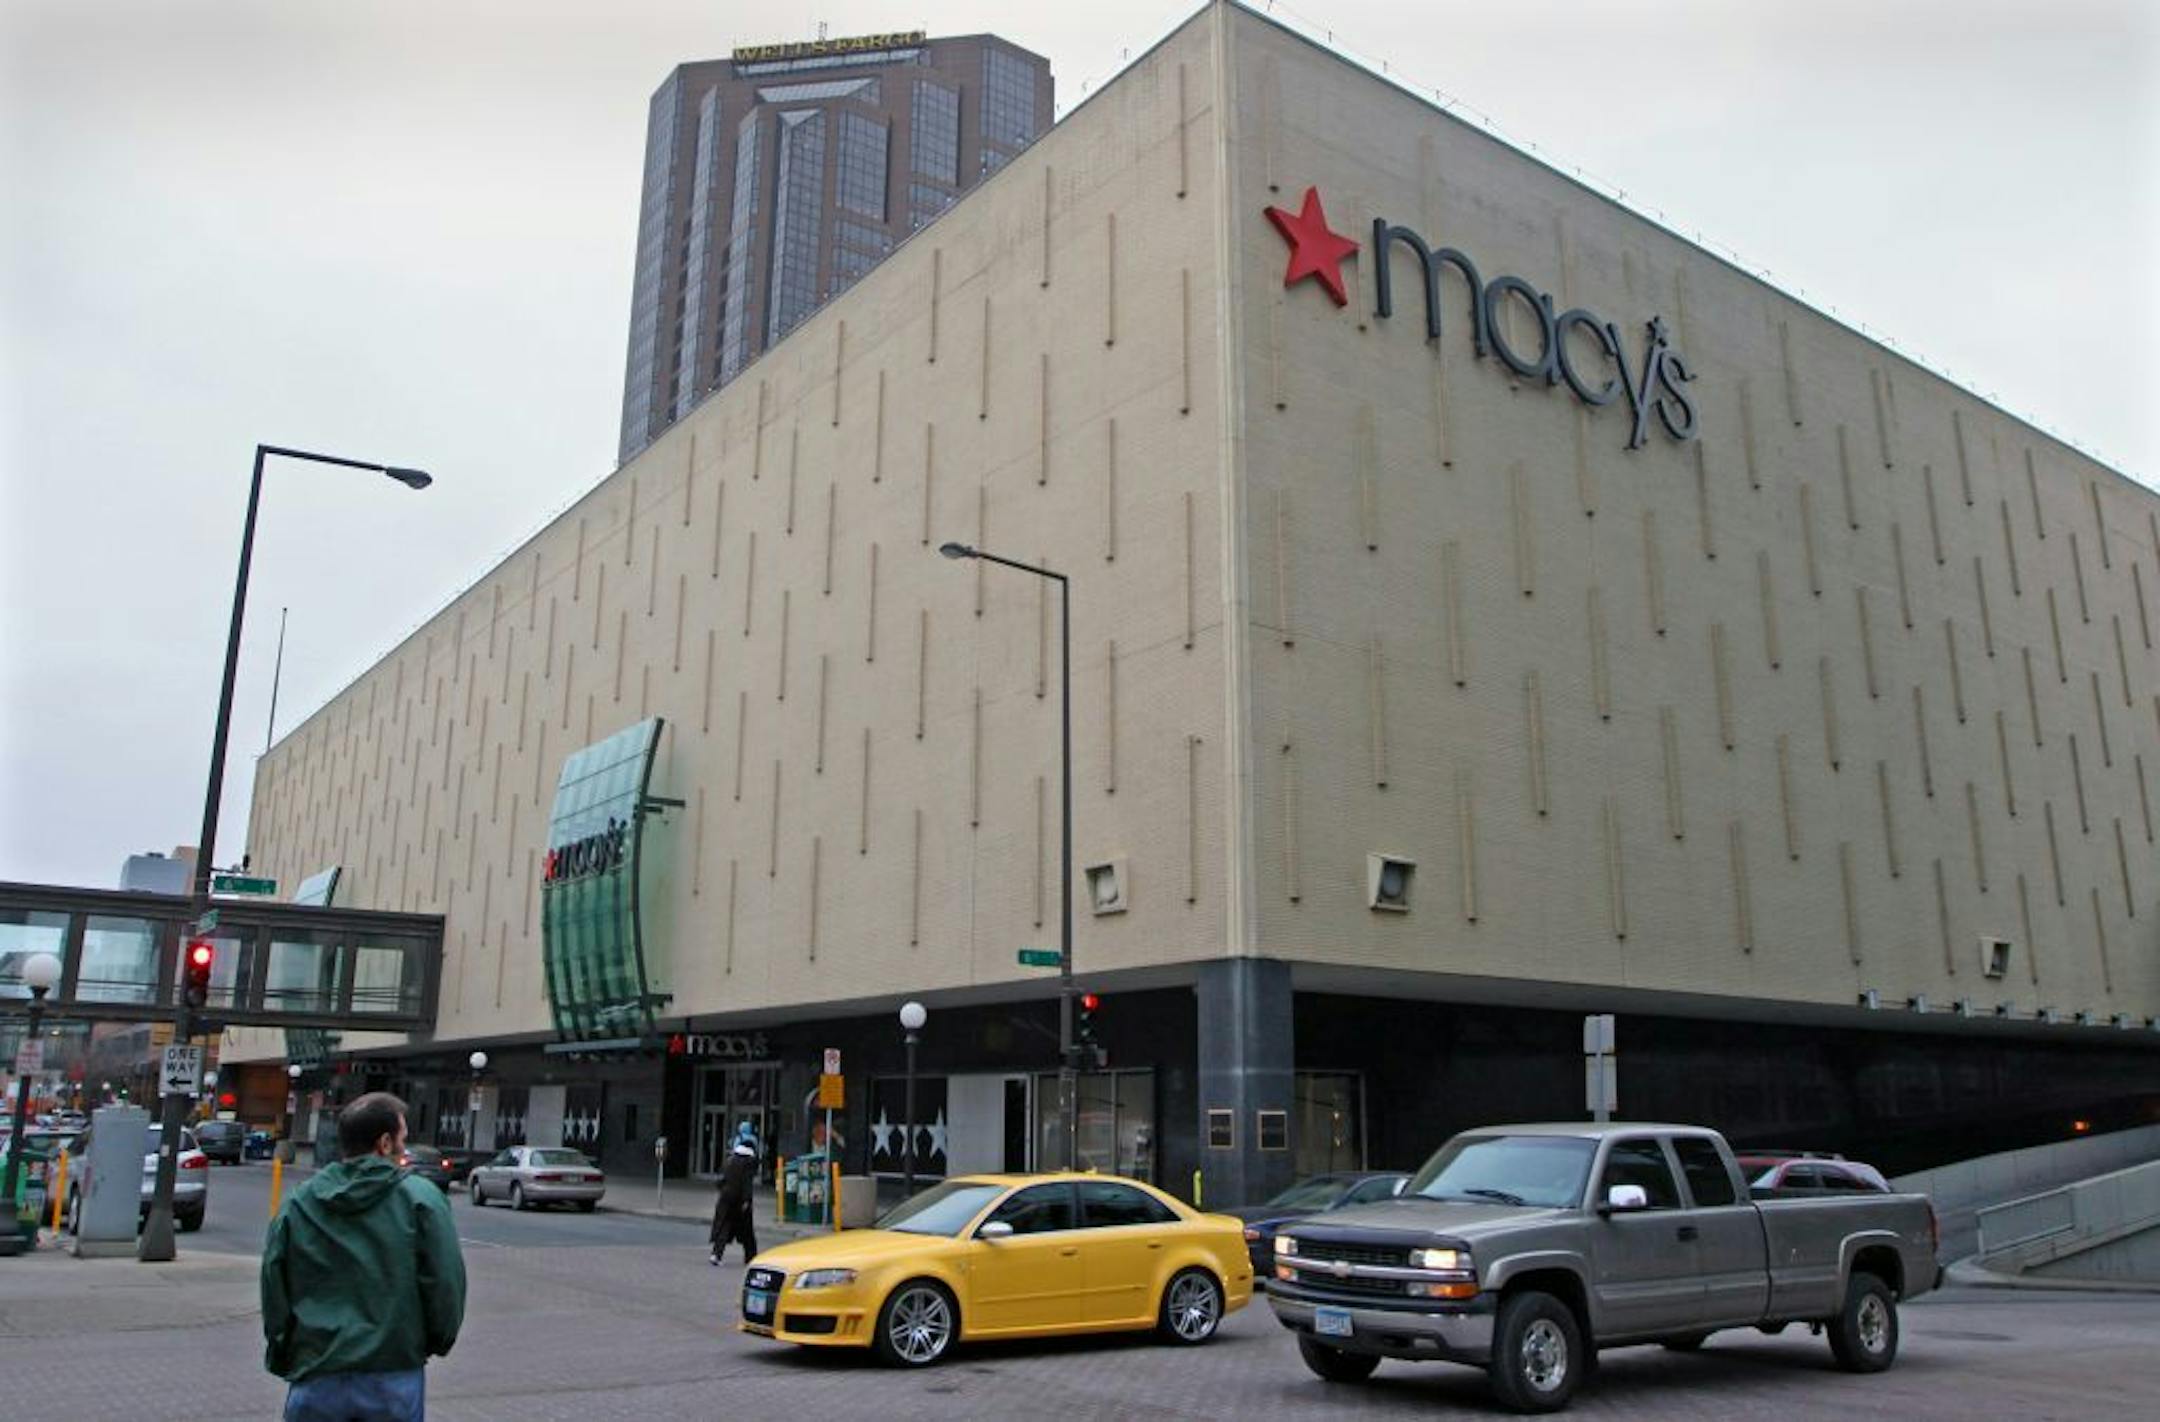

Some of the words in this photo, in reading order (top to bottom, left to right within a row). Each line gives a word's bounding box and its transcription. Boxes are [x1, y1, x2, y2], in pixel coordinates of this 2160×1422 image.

[833, 31, 927, 51] FARGO
[1373, 217, 1698, 450] macy's
[168, 1048, 198, 1060] ONE
[166, 1061, 195, 1073] WAY
